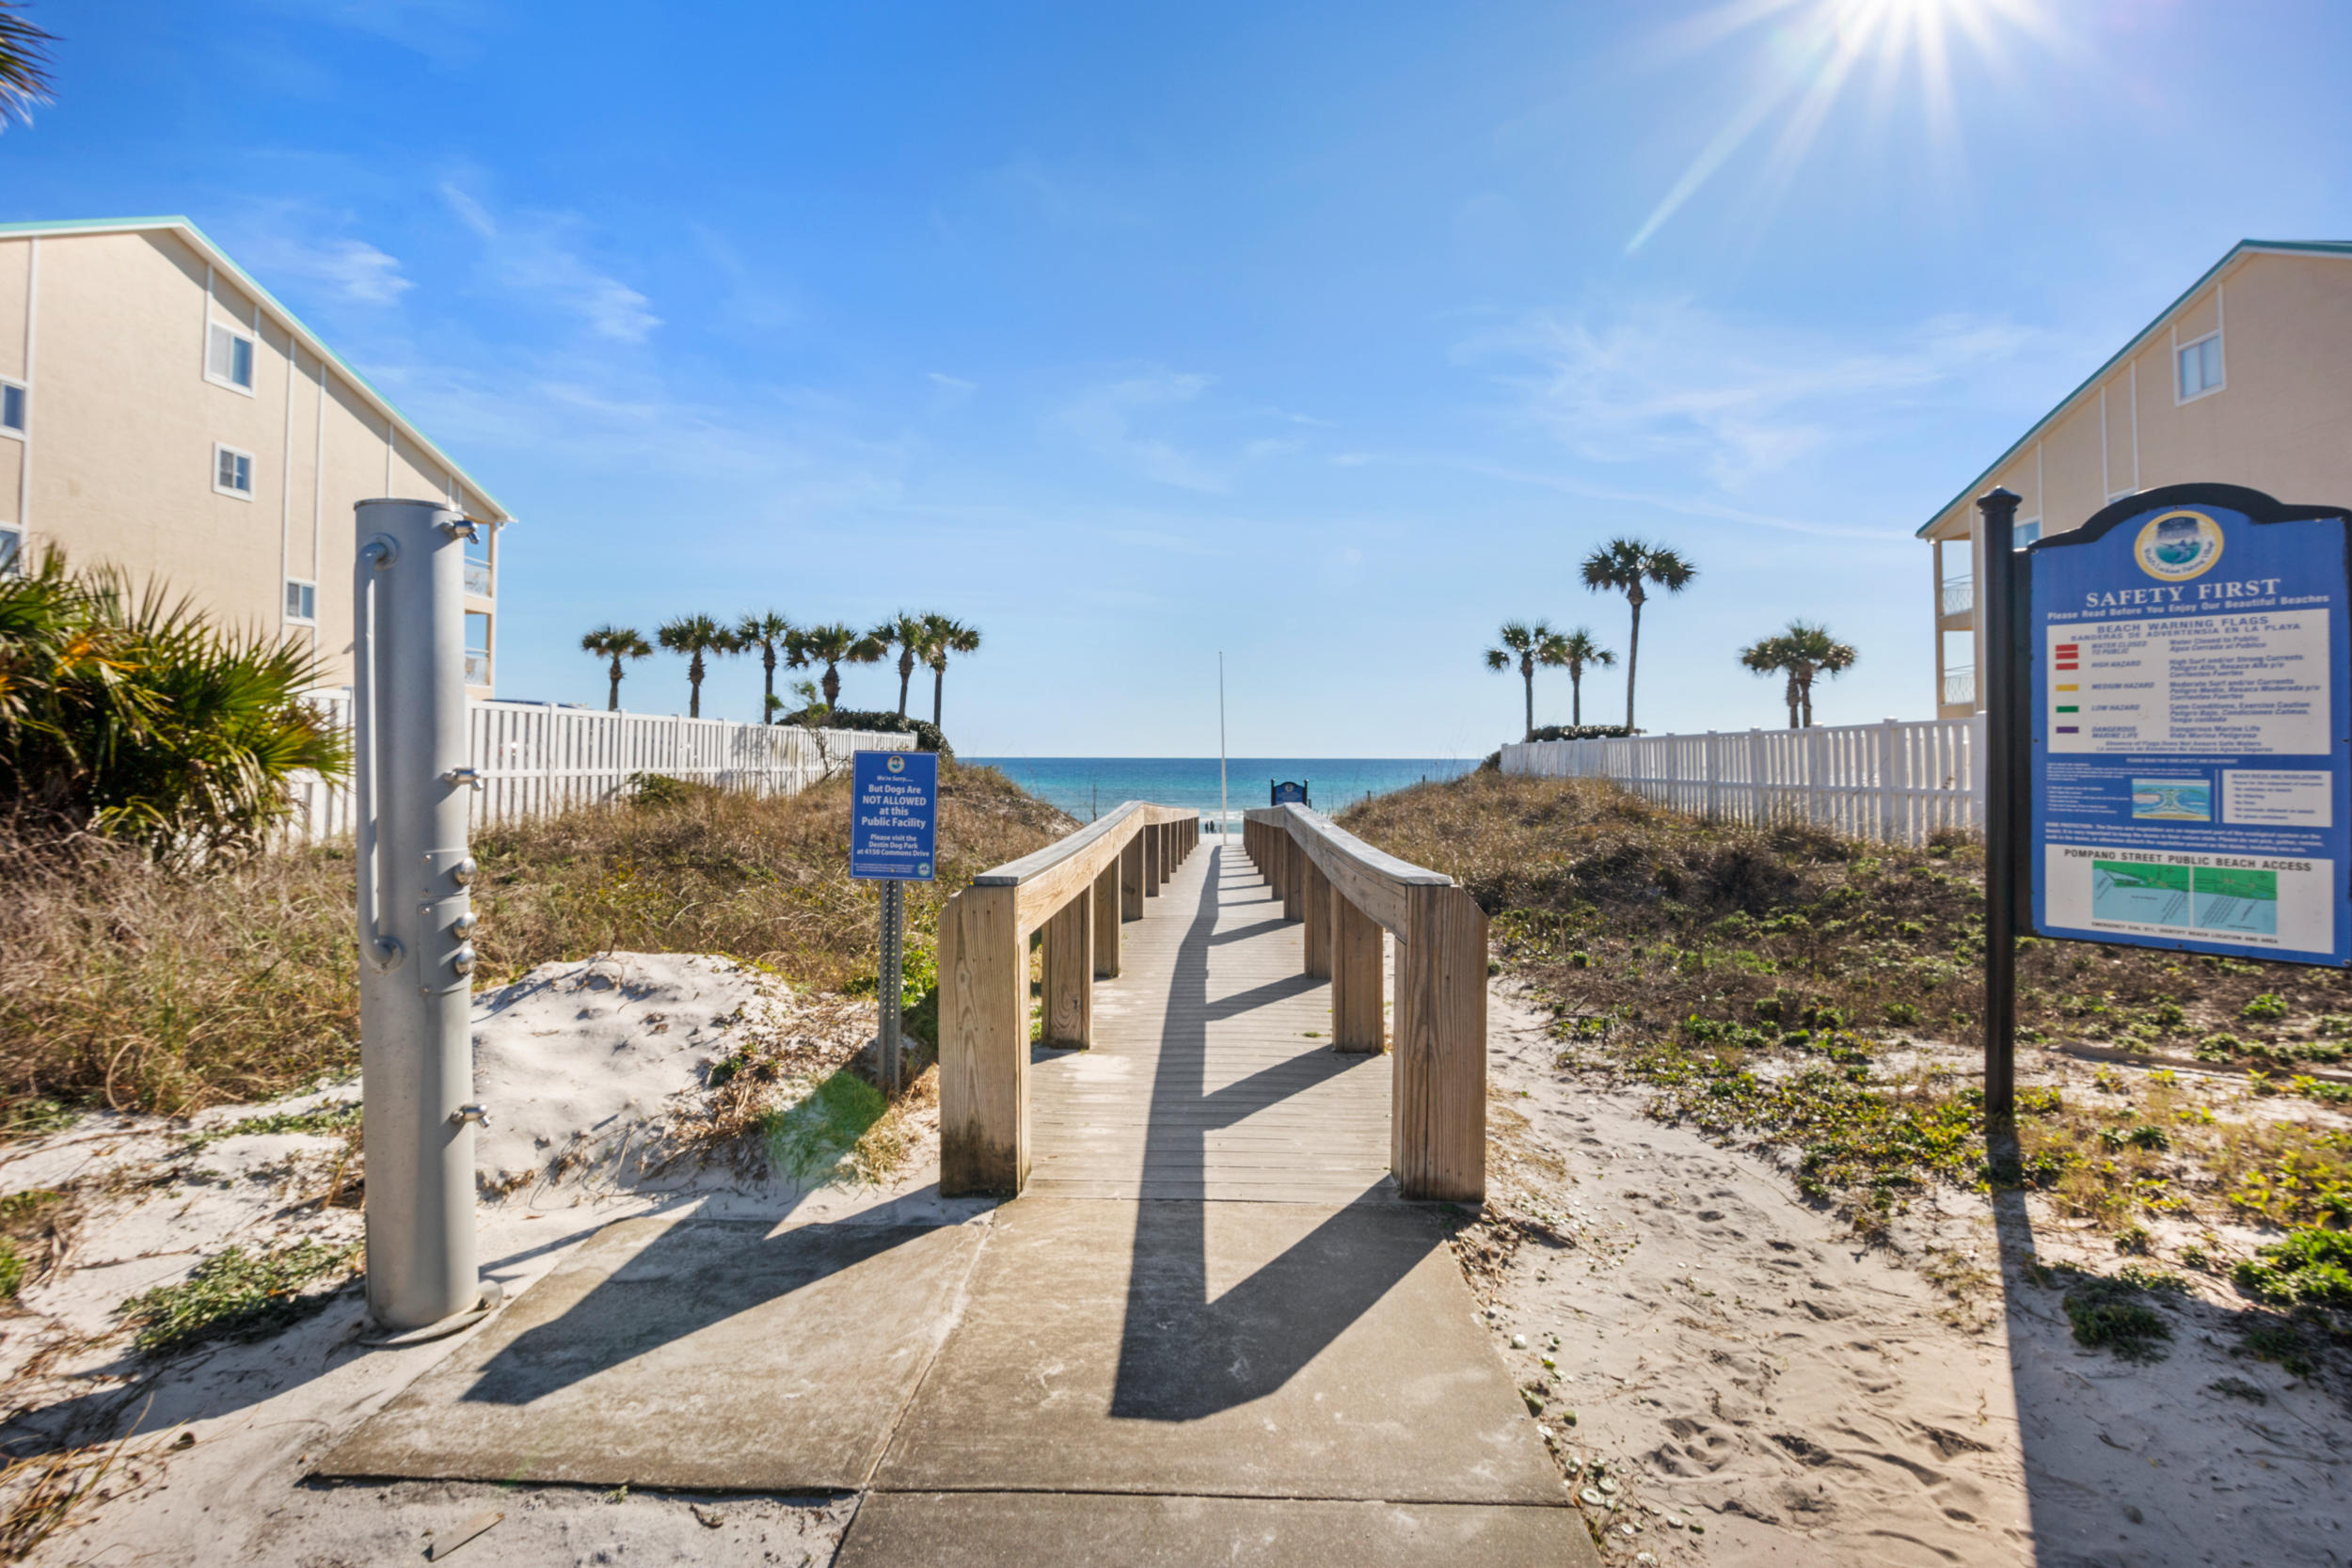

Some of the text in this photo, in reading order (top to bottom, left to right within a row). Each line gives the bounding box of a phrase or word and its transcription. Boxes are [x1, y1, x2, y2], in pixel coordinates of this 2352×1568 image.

[2086, 578, 2280, 608] SAFETY FIRST
[2047, 612, 2078, 621] Please
[2082, 610, 2106, 618] Read
[2109, 608, 2142, 616] Before
[2169, 603, 2197, 612] Enjoy
[2201, 602, 2220, 610] Our
[2225, 597, 2276, 609] Beautiful
[2280, 595, 2329, 605] Beaches
[2097, 616, 2269, 633] BEACH WARNING FLAGS
[2071, 633, 2123, 641] BANDERAS
[868, 784, 921, 795] But Dogs Are
[863, 796, 927, 806] NOT ALLOWED
[879, 806, 909, 816] at this
[861, 816, 927, 830] Public Facility
[892, 833, 905, 842] visit
[890, 842, 902, 850] Dog
[2064, 848, 2312, 872] POMPANO STREET PUBLIC BEACH ACCESS
